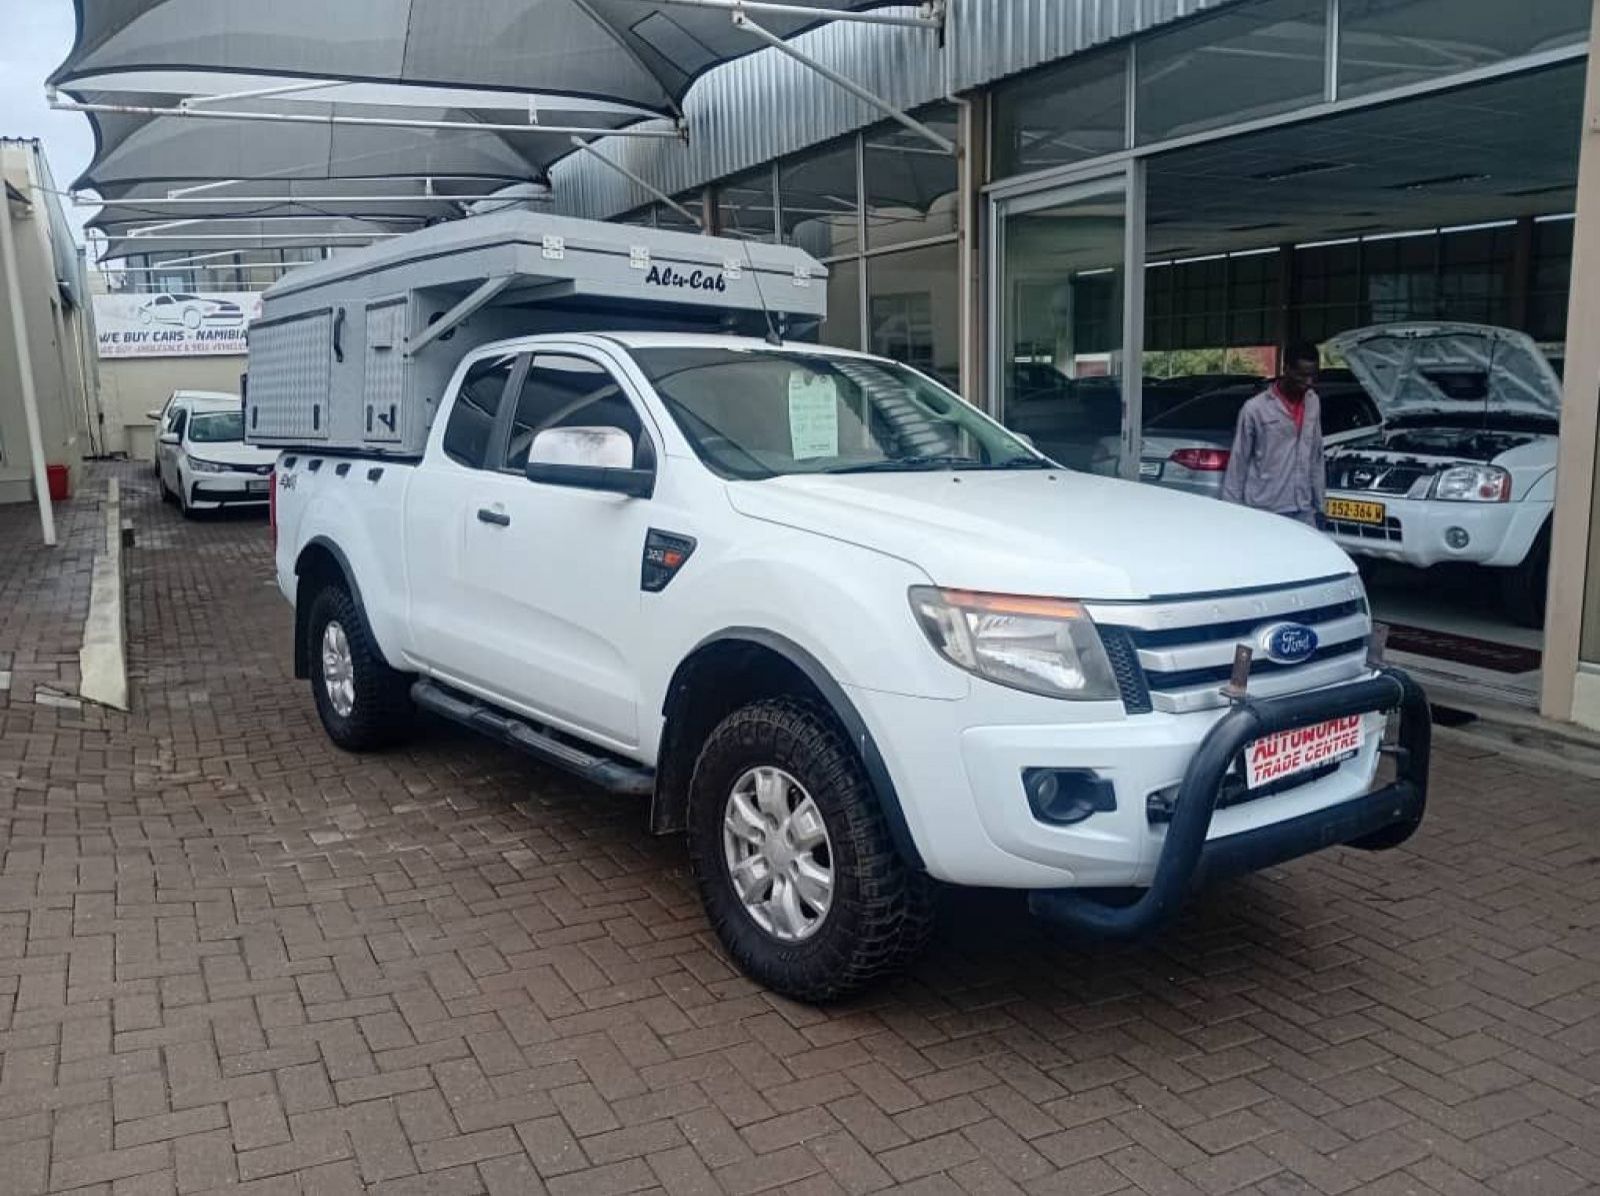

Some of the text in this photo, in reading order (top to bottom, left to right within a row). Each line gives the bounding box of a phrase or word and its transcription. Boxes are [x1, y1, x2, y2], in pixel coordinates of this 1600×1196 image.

[645, 265, 727, 292] Alu-Cab
[100, 331, 120, 343] WE
[124, 331, 149, 343] BUY
[153, 330, 184, 342] CARS
[196, 329, 248, 341] NAMIBIA
[1281, 630, 1310, 653] Ford
[1253, 714, 1361, 762] AUTOWORLD
[1254, 730, 1360, 782] TRADE CENTRE
